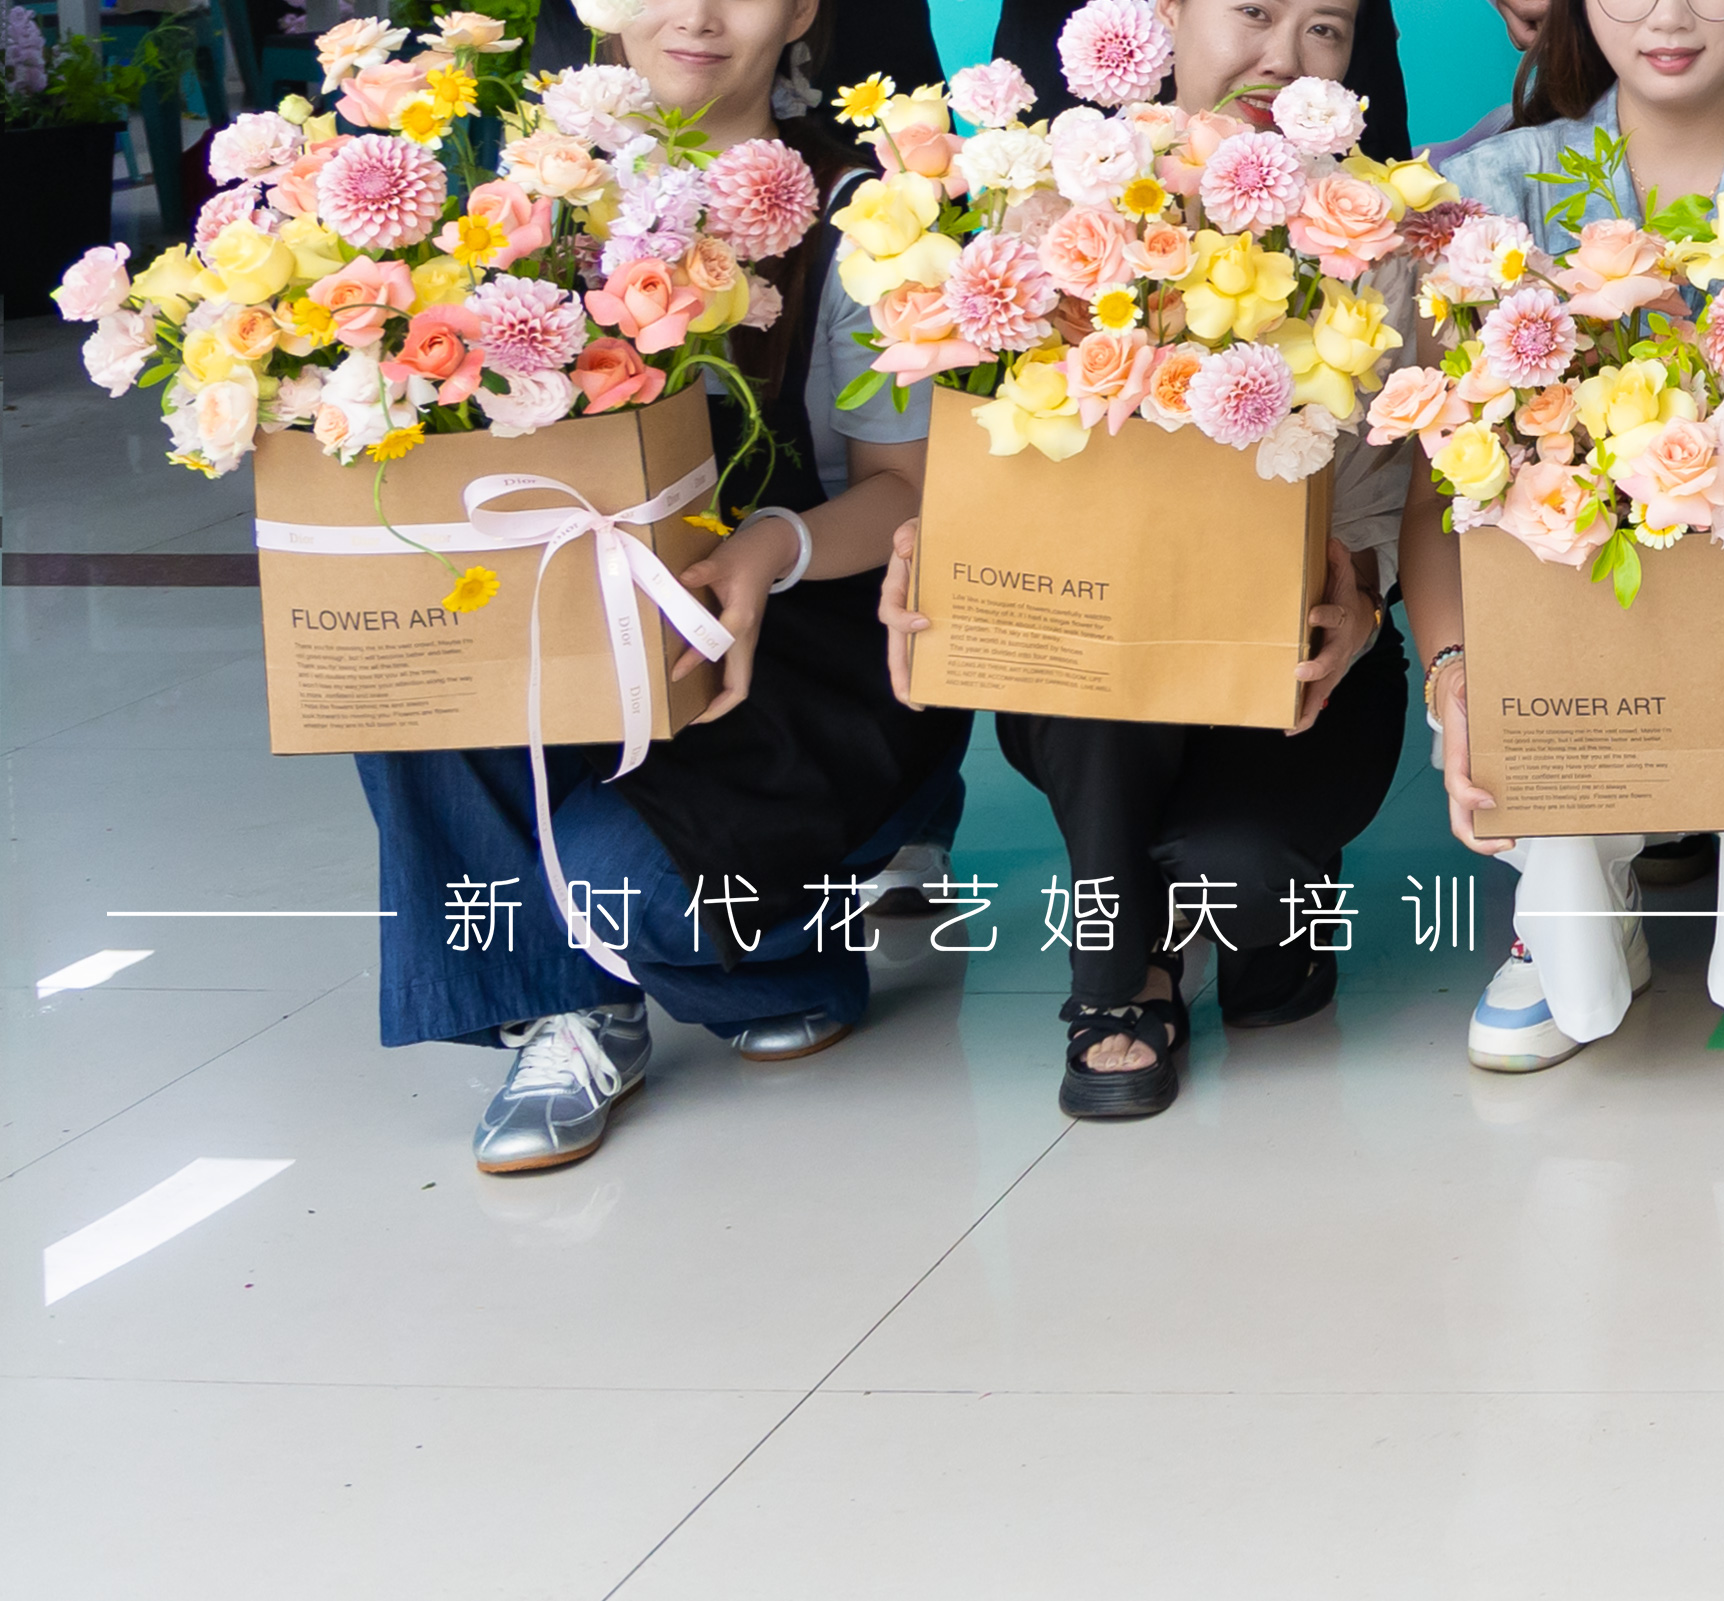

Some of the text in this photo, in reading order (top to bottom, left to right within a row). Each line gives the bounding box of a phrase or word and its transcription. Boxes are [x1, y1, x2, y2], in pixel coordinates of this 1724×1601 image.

[954, 563, 1109, 600] FLOWER ART
[292, 609, 400, 631] FLOWER
[619, 616, 631, 647] Dior
[629, 685, 641, 715] Dior
[1502, 697, 1666, 716] FLOWER ART
